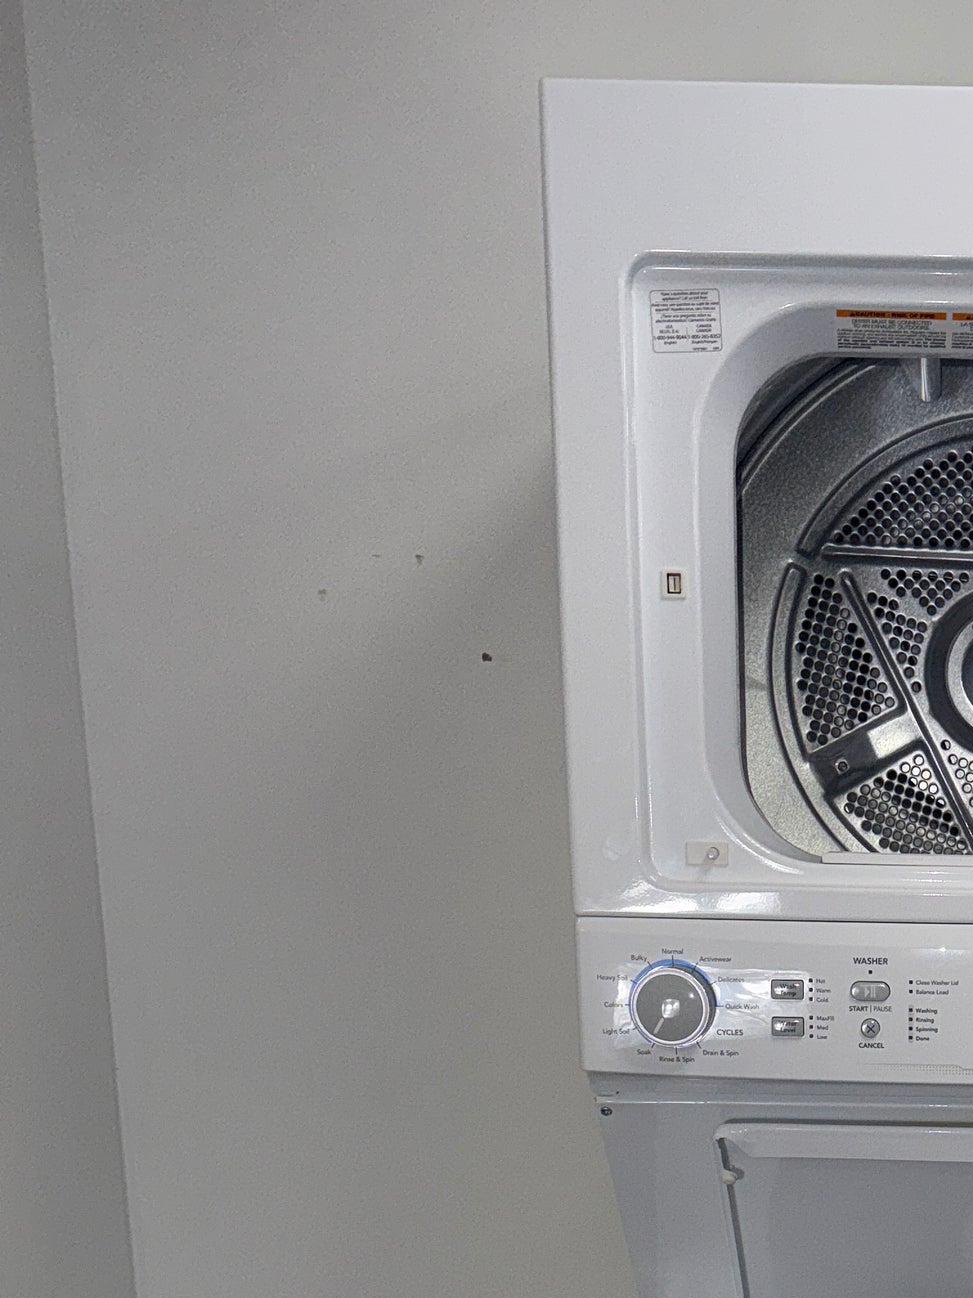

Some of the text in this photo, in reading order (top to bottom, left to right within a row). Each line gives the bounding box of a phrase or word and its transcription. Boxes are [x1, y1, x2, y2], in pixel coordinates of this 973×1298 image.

[630, 954, 647, 962] Bulky
[853, 957, 888, 965] WASHER
[916, 1026, 938, 1034] Spinning
